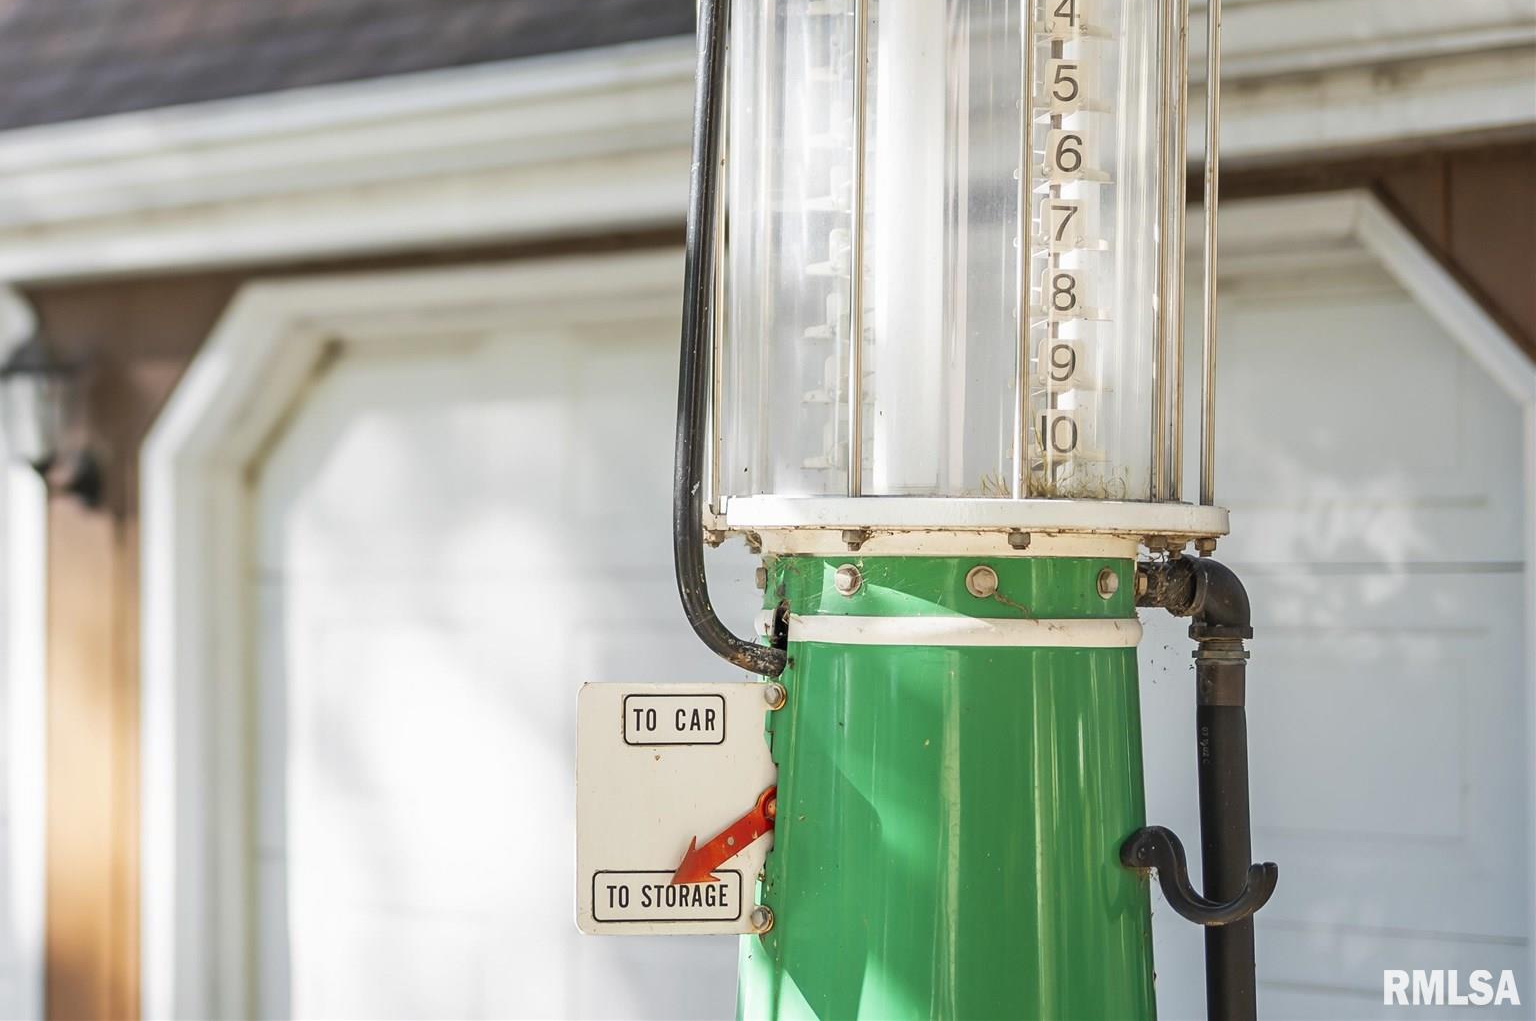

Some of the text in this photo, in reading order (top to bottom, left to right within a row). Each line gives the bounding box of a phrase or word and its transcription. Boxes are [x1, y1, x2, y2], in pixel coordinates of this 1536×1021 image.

[1052, 64, 1079, 102] 5
[1055, 134, 1083, 172] 6
[1051, 205, 1078, 241] 7
[1052, 273, 1077, 311] 8
[1050, 343, 1076, 382] 9
[1041, 415, 1078, 453] 10
[633, 708, 716, 732] TO CAR
[607, 883, 729, 908] TO STORAGE
